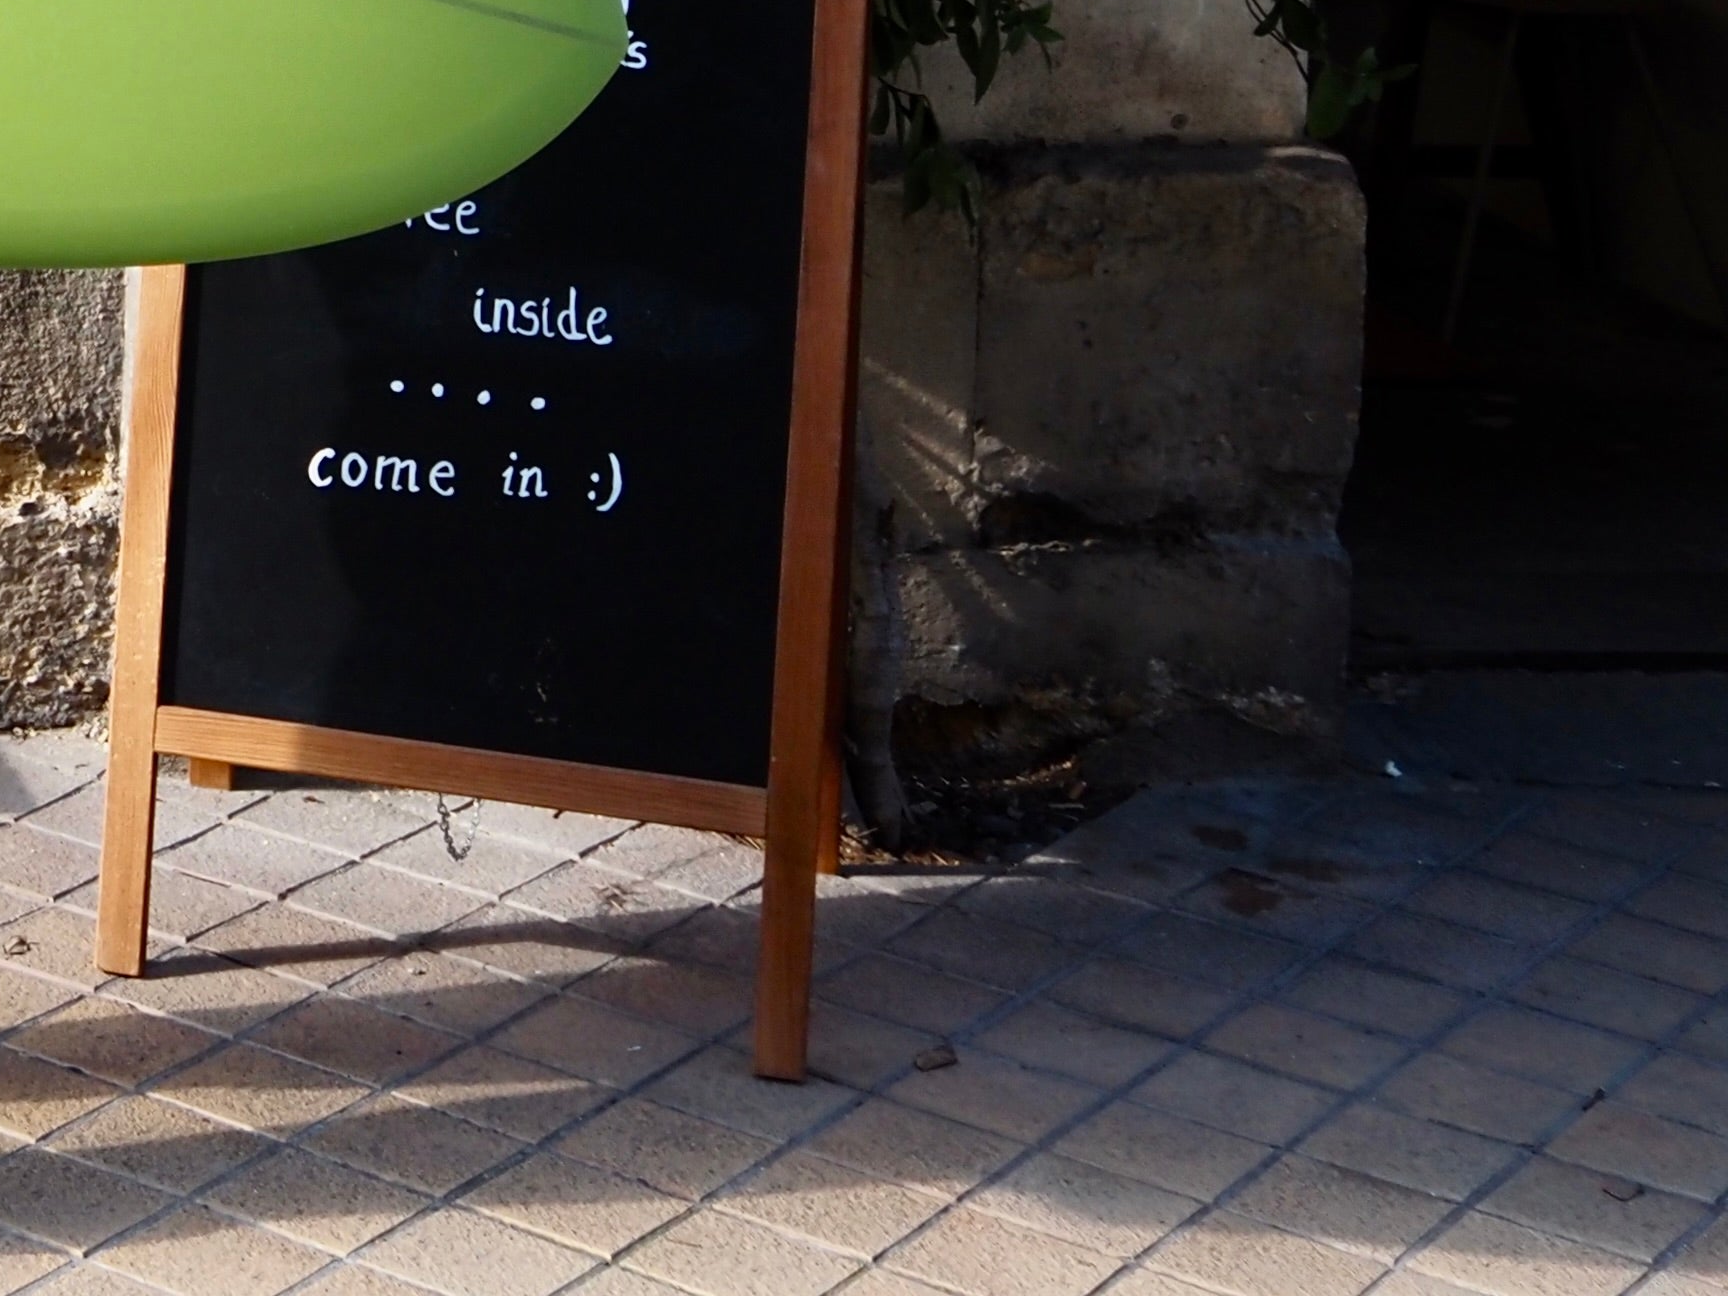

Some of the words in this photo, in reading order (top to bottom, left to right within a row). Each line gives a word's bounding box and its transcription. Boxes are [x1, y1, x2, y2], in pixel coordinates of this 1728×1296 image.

[404, 200, 480, 235] ee
[472, 286, 613, 345] inside
[307, 446, 456, 497] come
[501, 451, 549, 499] in
